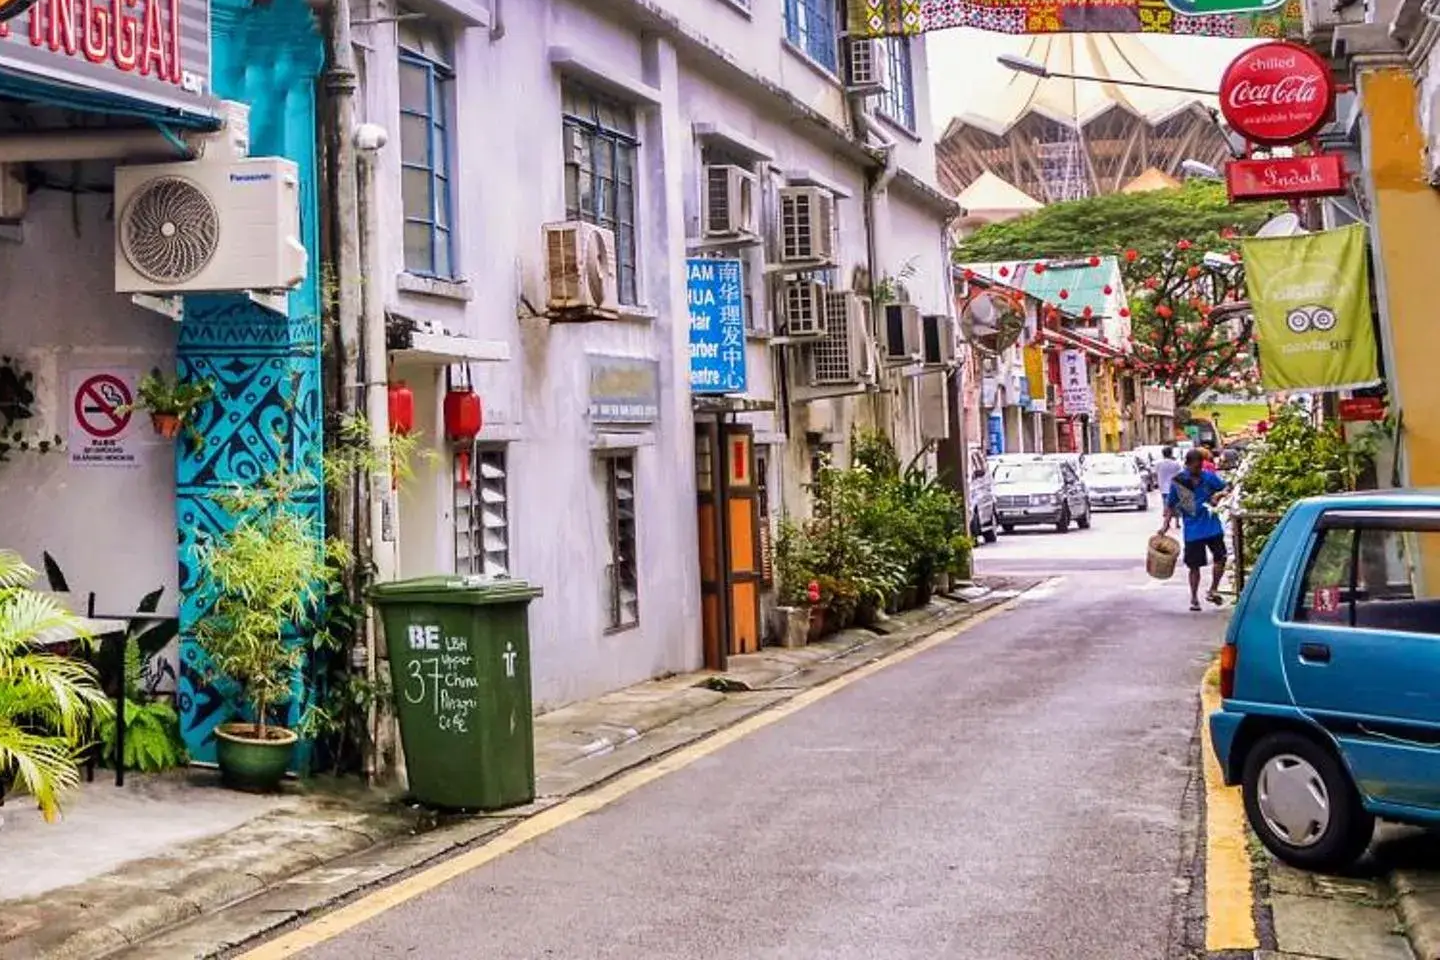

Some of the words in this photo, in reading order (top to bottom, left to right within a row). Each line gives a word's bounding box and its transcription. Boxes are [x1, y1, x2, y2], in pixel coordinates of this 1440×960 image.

[1249, 56, 1295, 72] chilled
[1229, 74, 1323, 108] Coca-Cola
[689, 337, 719, 358] arber
[689, 367, 720, 385] entre
[409, 624, 441, 650] BE
[405, 657, 444, 715] 37
